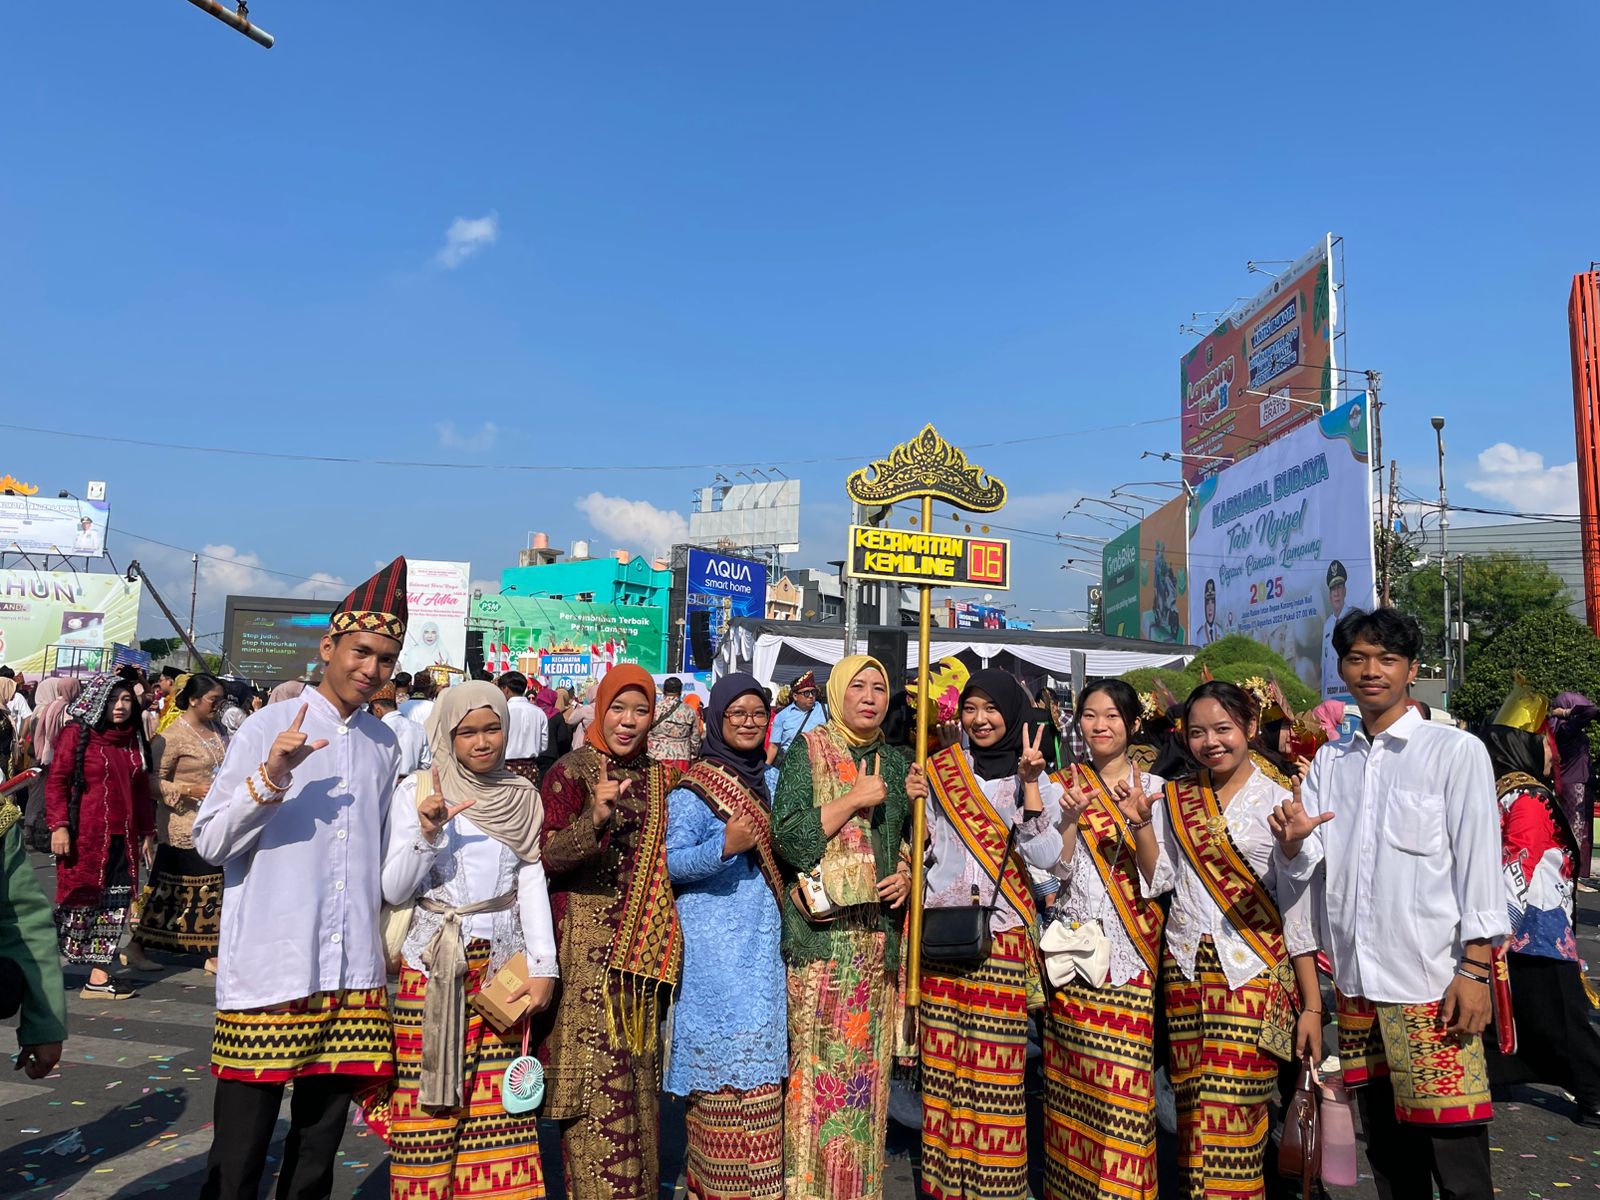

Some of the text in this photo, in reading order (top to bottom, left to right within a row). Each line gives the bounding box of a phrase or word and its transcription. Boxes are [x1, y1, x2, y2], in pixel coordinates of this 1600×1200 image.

[1253, 324, 1271, 347] ARTIS
[1188, 356, 1234, 408] Lampung
[1262, 402, 1286, 422] GRATIS
[1212, 452, 1329, 529] KARNAVAL BUDAYA
[1227, 498, 1306, 554] Tari Ngigel
[855, 528, 1001, 577] KECAMATAN 06
[864, 551, 954, 577] KEMILING
[1106, 544, 1136, 576] GrabBike
[1279, 538, 1321, 568] Lampung
[705, 559, 752, 582] AQUA
[0, 575, 75, 603] HUN
[705, 579, 752, 593] smart home
[1249, 576, 1283, 605] 2025
[406, 592, 424, 605] dul
[423, 592, 459, 606] Adha
[481, 602, 499, 610] PSM
[1269, 604, 1280, 613] Depan
[1280, 601, 1294, 610] Karang
[619, 617, 650, 625] Terbaik
[1272, 615, 1283, 624] 2025
[1283, 612, 1296, 622] Pukul
[600, 625, 639, 636] Lampung
[544, 663, 588, 673] KEDATON
[559, 679, 571, 688] 08
